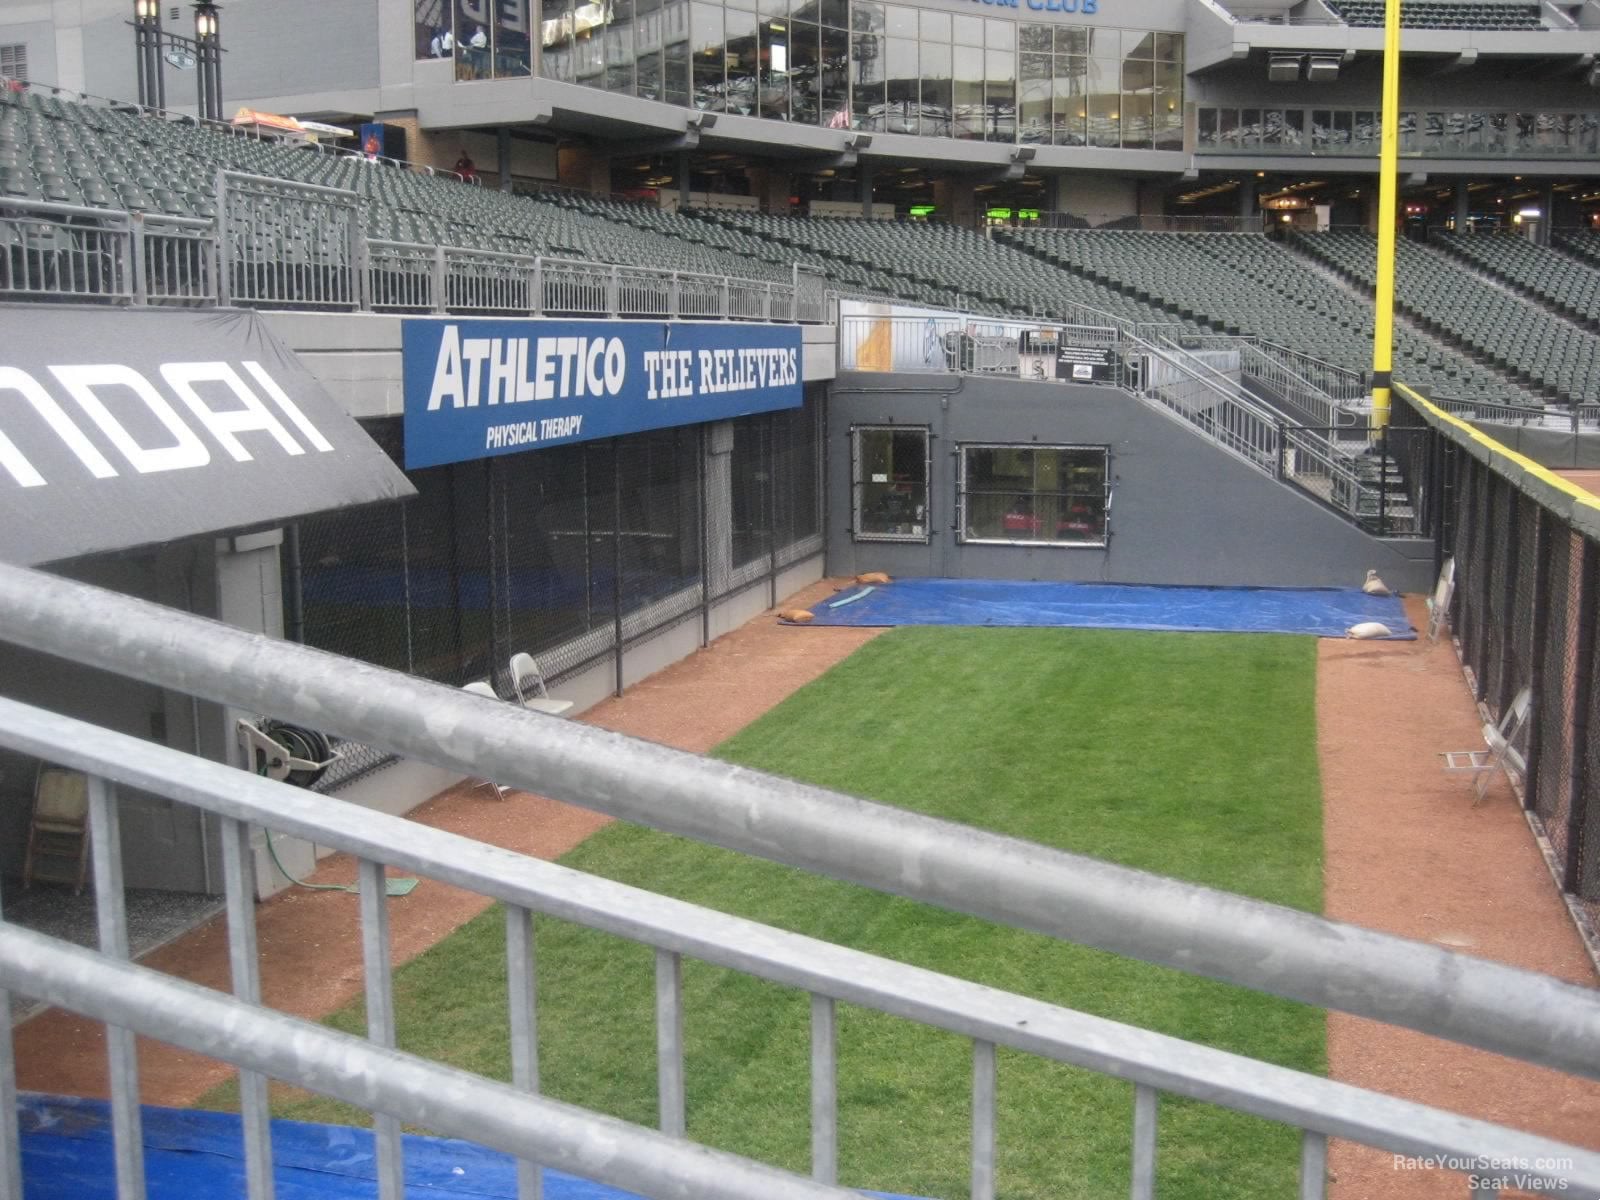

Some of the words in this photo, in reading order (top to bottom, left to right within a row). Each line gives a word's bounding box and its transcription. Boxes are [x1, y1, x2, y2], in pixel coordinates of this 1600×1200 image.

[427, 325, 626, 411] ATHLETICO
[644, 350, 694, 400] THE
[699, 347, 798, 394] RELIEVERS
[486, 421, 538, 450] PHYSICAL
[540, 414, 583, 441] THERAPY
